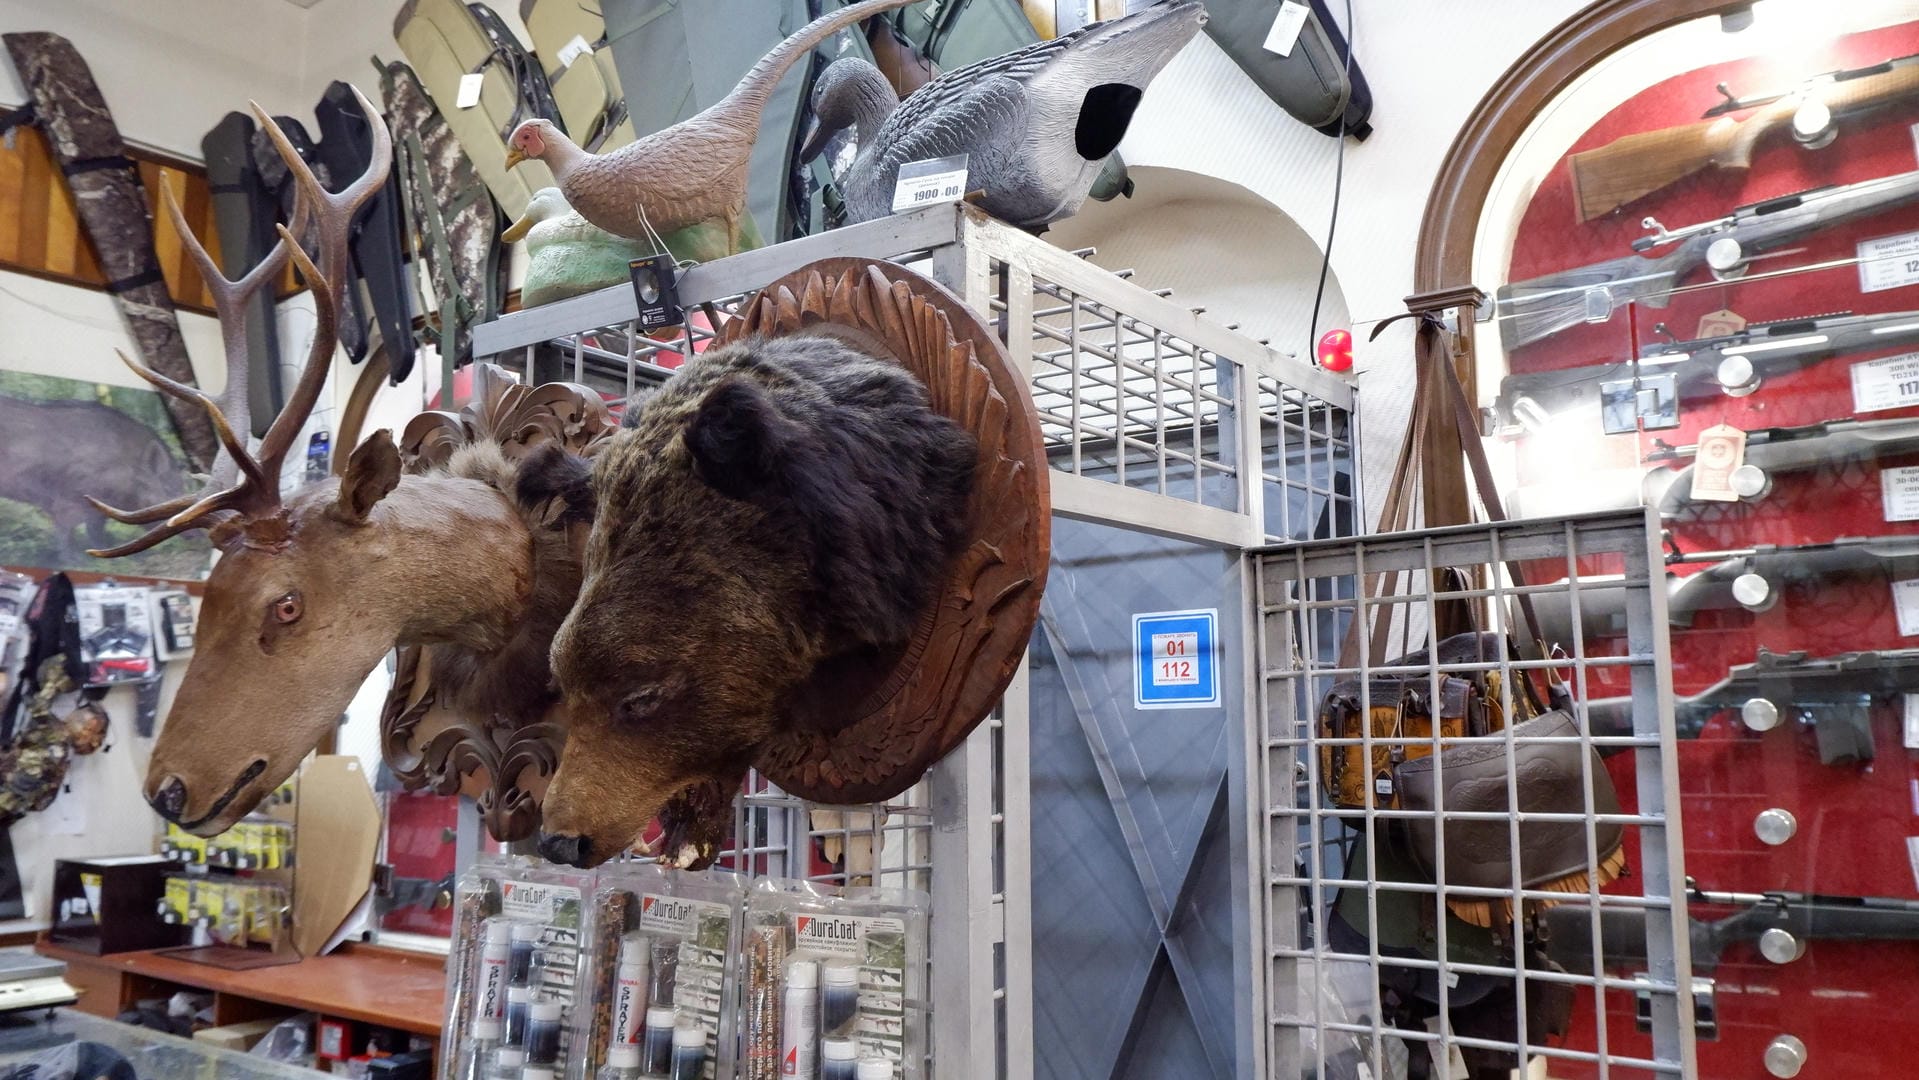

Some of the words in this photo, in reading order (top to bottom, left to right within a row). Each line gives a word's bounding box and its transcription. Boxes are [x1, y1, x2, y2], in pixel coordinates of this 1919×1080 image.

[914, 189, 939, 201] 1900
[1167, 640, 1185, 656] 01
[1162, 661, 1191, 678] 112
[811, 918, 857, 940] DuraCoat
[484, 965, 500, 1018] SPRAYER
[616, 986, 632, 1043] SPRAYER
